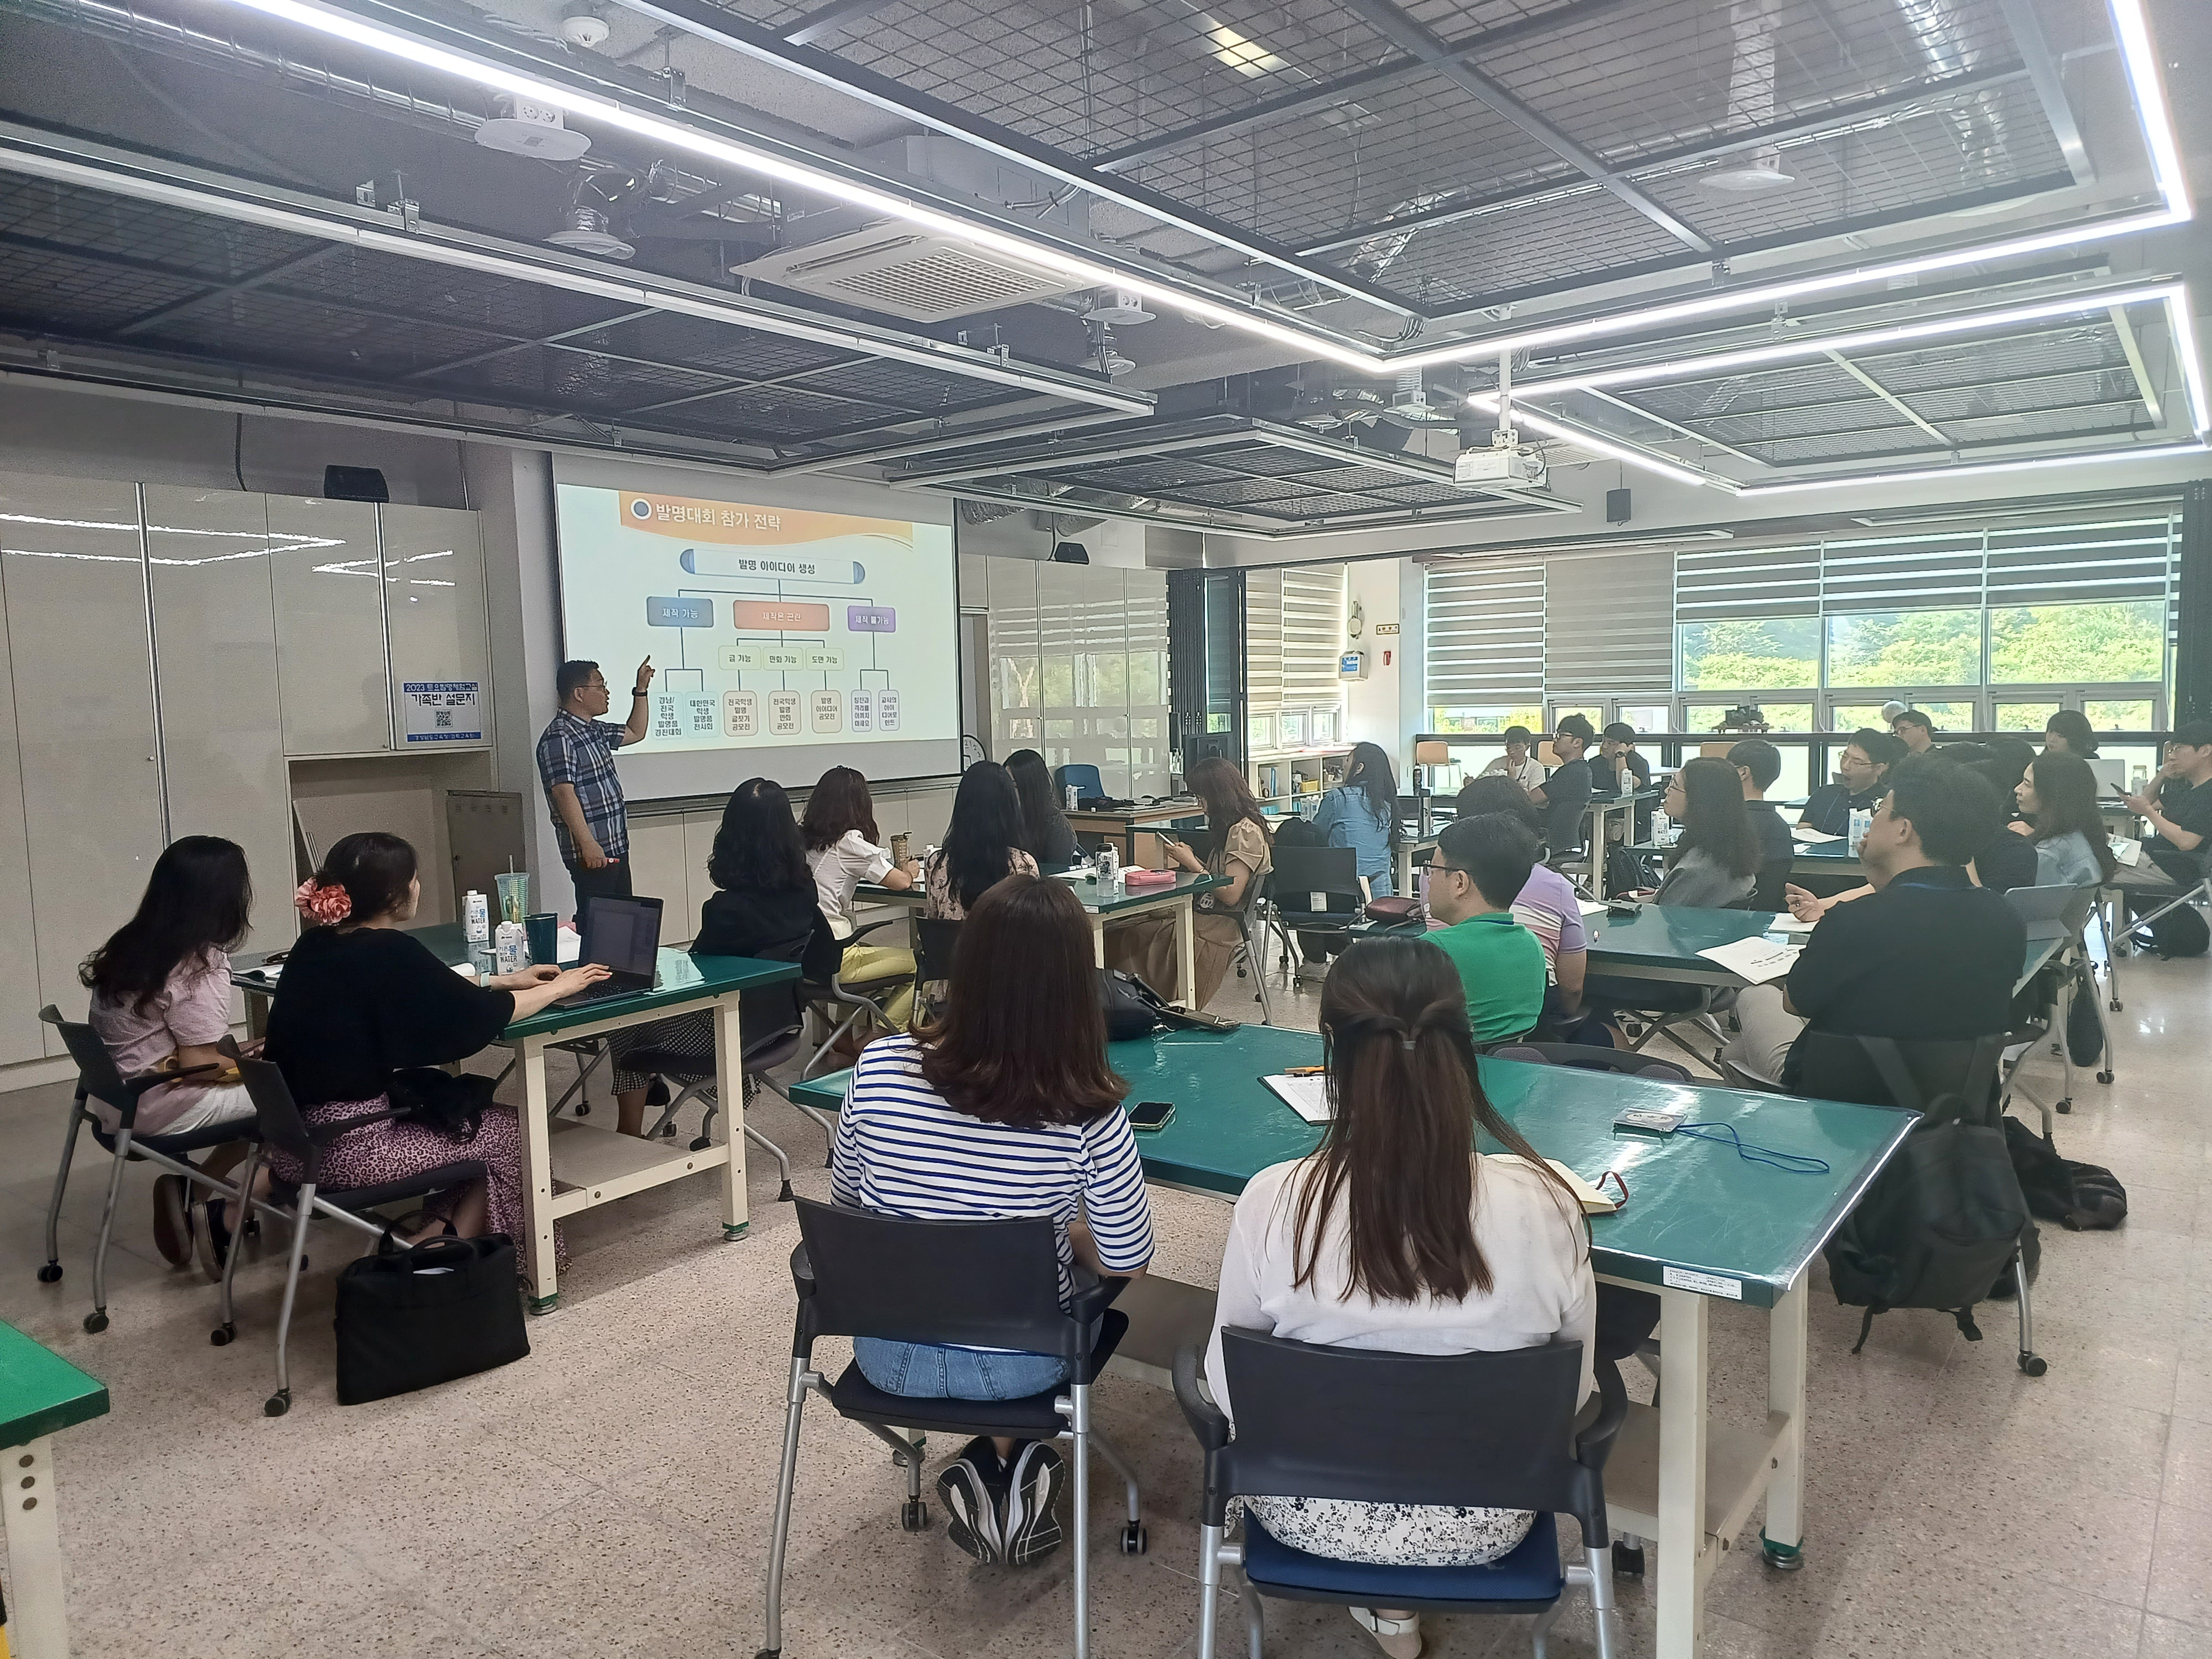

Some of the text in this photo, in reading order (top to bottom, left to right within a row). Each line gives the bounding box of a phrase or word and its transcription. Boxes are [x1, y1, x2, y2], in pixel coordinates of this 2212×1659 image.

[656, 504, 781, 531] 발명대회 참가 전략
[739, 559, 815, 574] 발명 아이디어 생성
[662, 608, 698, 618] 제작 가능
[763, 612, 801, 622] 제작은 곤란
[855, 615, 868, 624] 제작
[411, 693, 475, 706] 가족반 설문지
